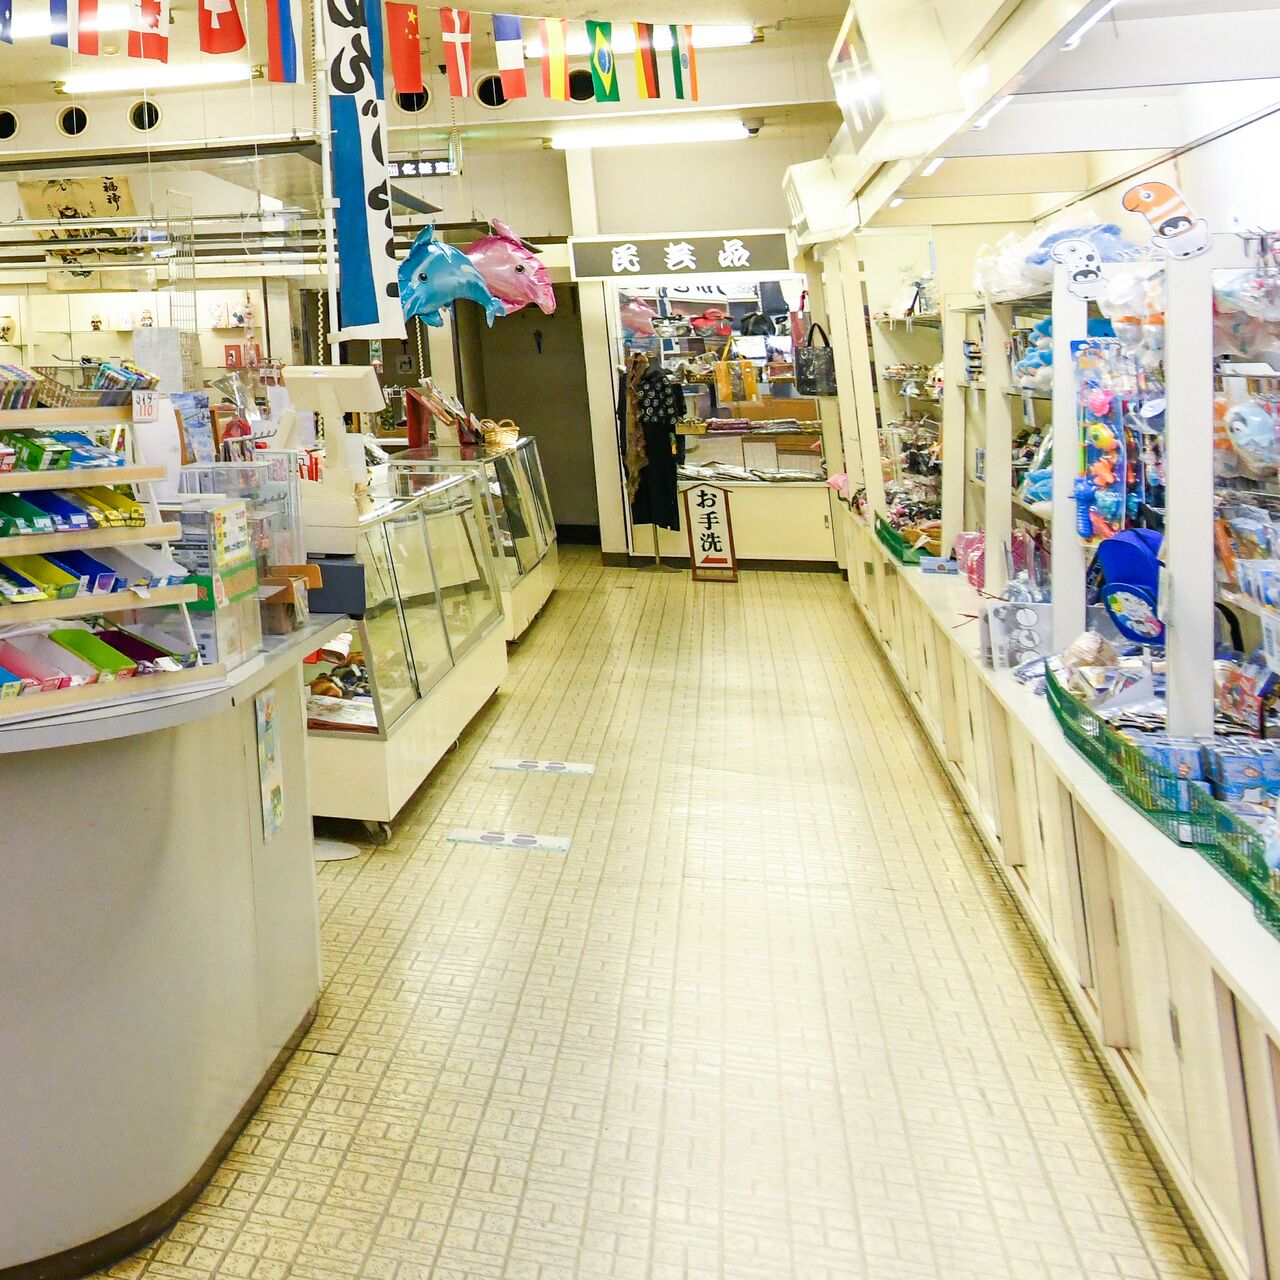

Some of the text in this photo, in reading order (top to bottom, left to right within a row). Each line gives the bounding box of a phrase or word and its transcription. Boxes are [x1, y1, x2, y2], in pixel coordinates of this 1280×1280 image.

[101, 176, 122, 212] 福神
[611, 239, 750, 272] 民芸品
[695, 488, 725, 554] お手洗
